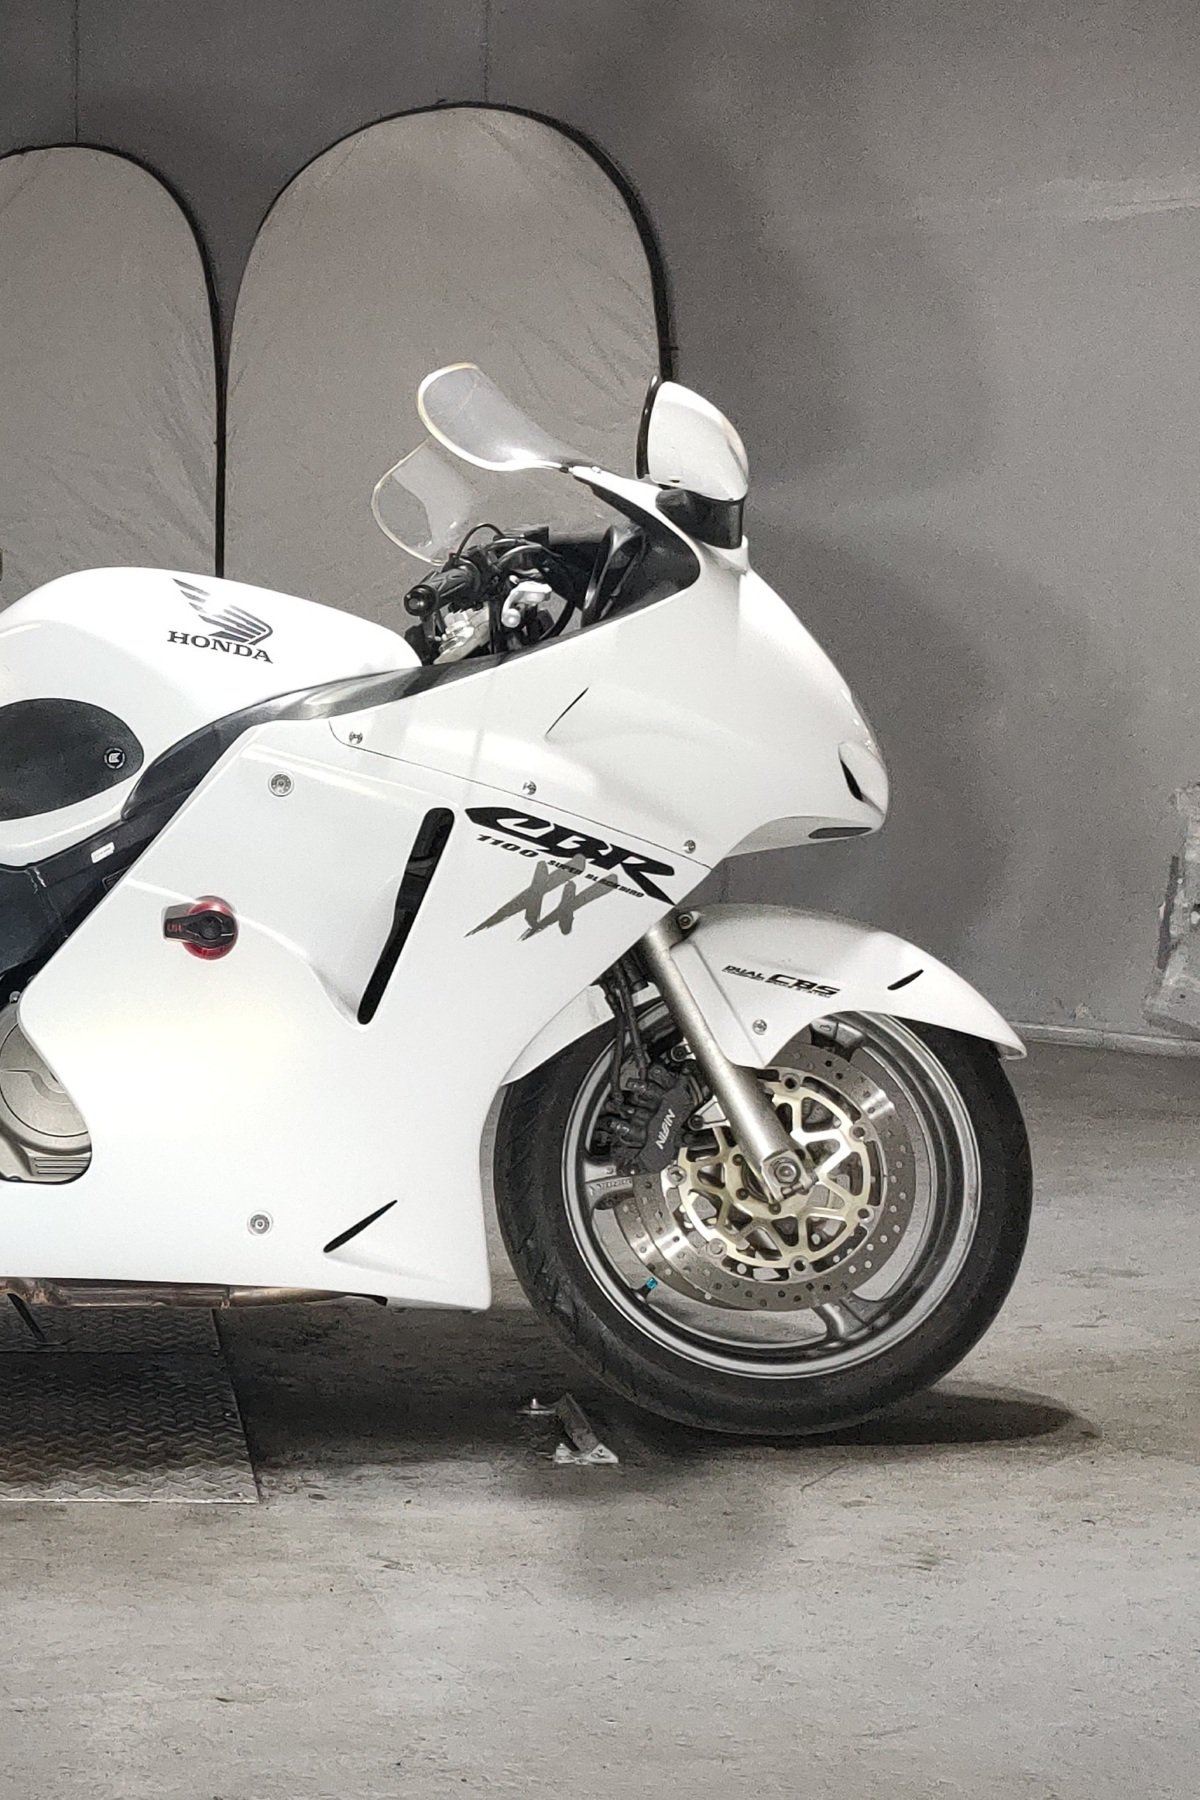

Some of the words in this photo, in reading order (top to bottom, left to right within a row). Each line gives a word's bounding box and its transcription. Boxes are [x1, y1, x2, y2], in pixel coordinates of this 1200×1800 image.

[167, 630, 274, 664] HONDA
[464, 806, 676, 906] CBR
[476, 833, 540, 858] 1100
[464, 853, 618, 941] XX
[721, 964, 765, 980] DUAL
[764, 973, 841, 996] CBS
